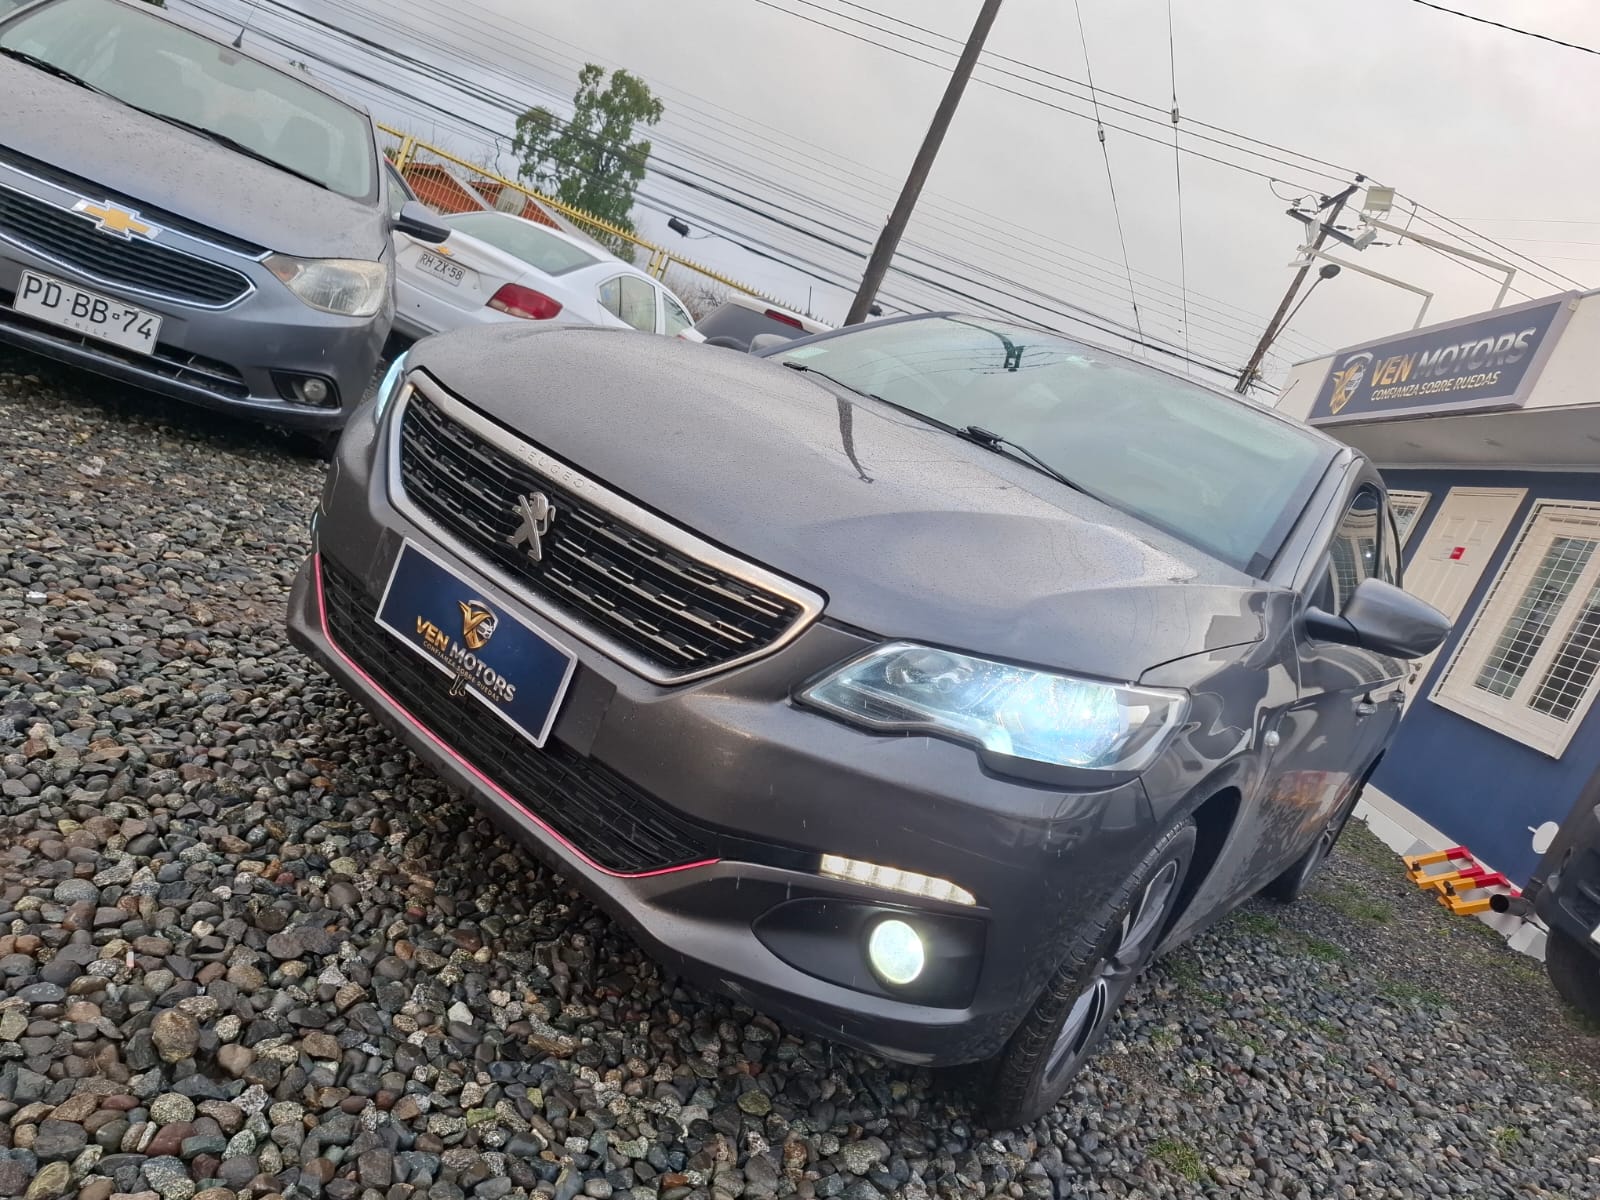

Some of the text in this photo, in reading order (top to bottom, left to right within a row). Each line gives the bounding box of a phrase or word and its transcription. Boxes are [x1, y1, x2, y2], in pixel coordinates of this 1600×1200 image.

[1371, 327, 1536, 387] VEN MOTORS
[1370, 371, 1501, 401] CONFIANZA SOBRE RUEDAS
[416, 615, 516, 702] VEN MOTORS
[423, 640, 456, 668] CONFIANZA
